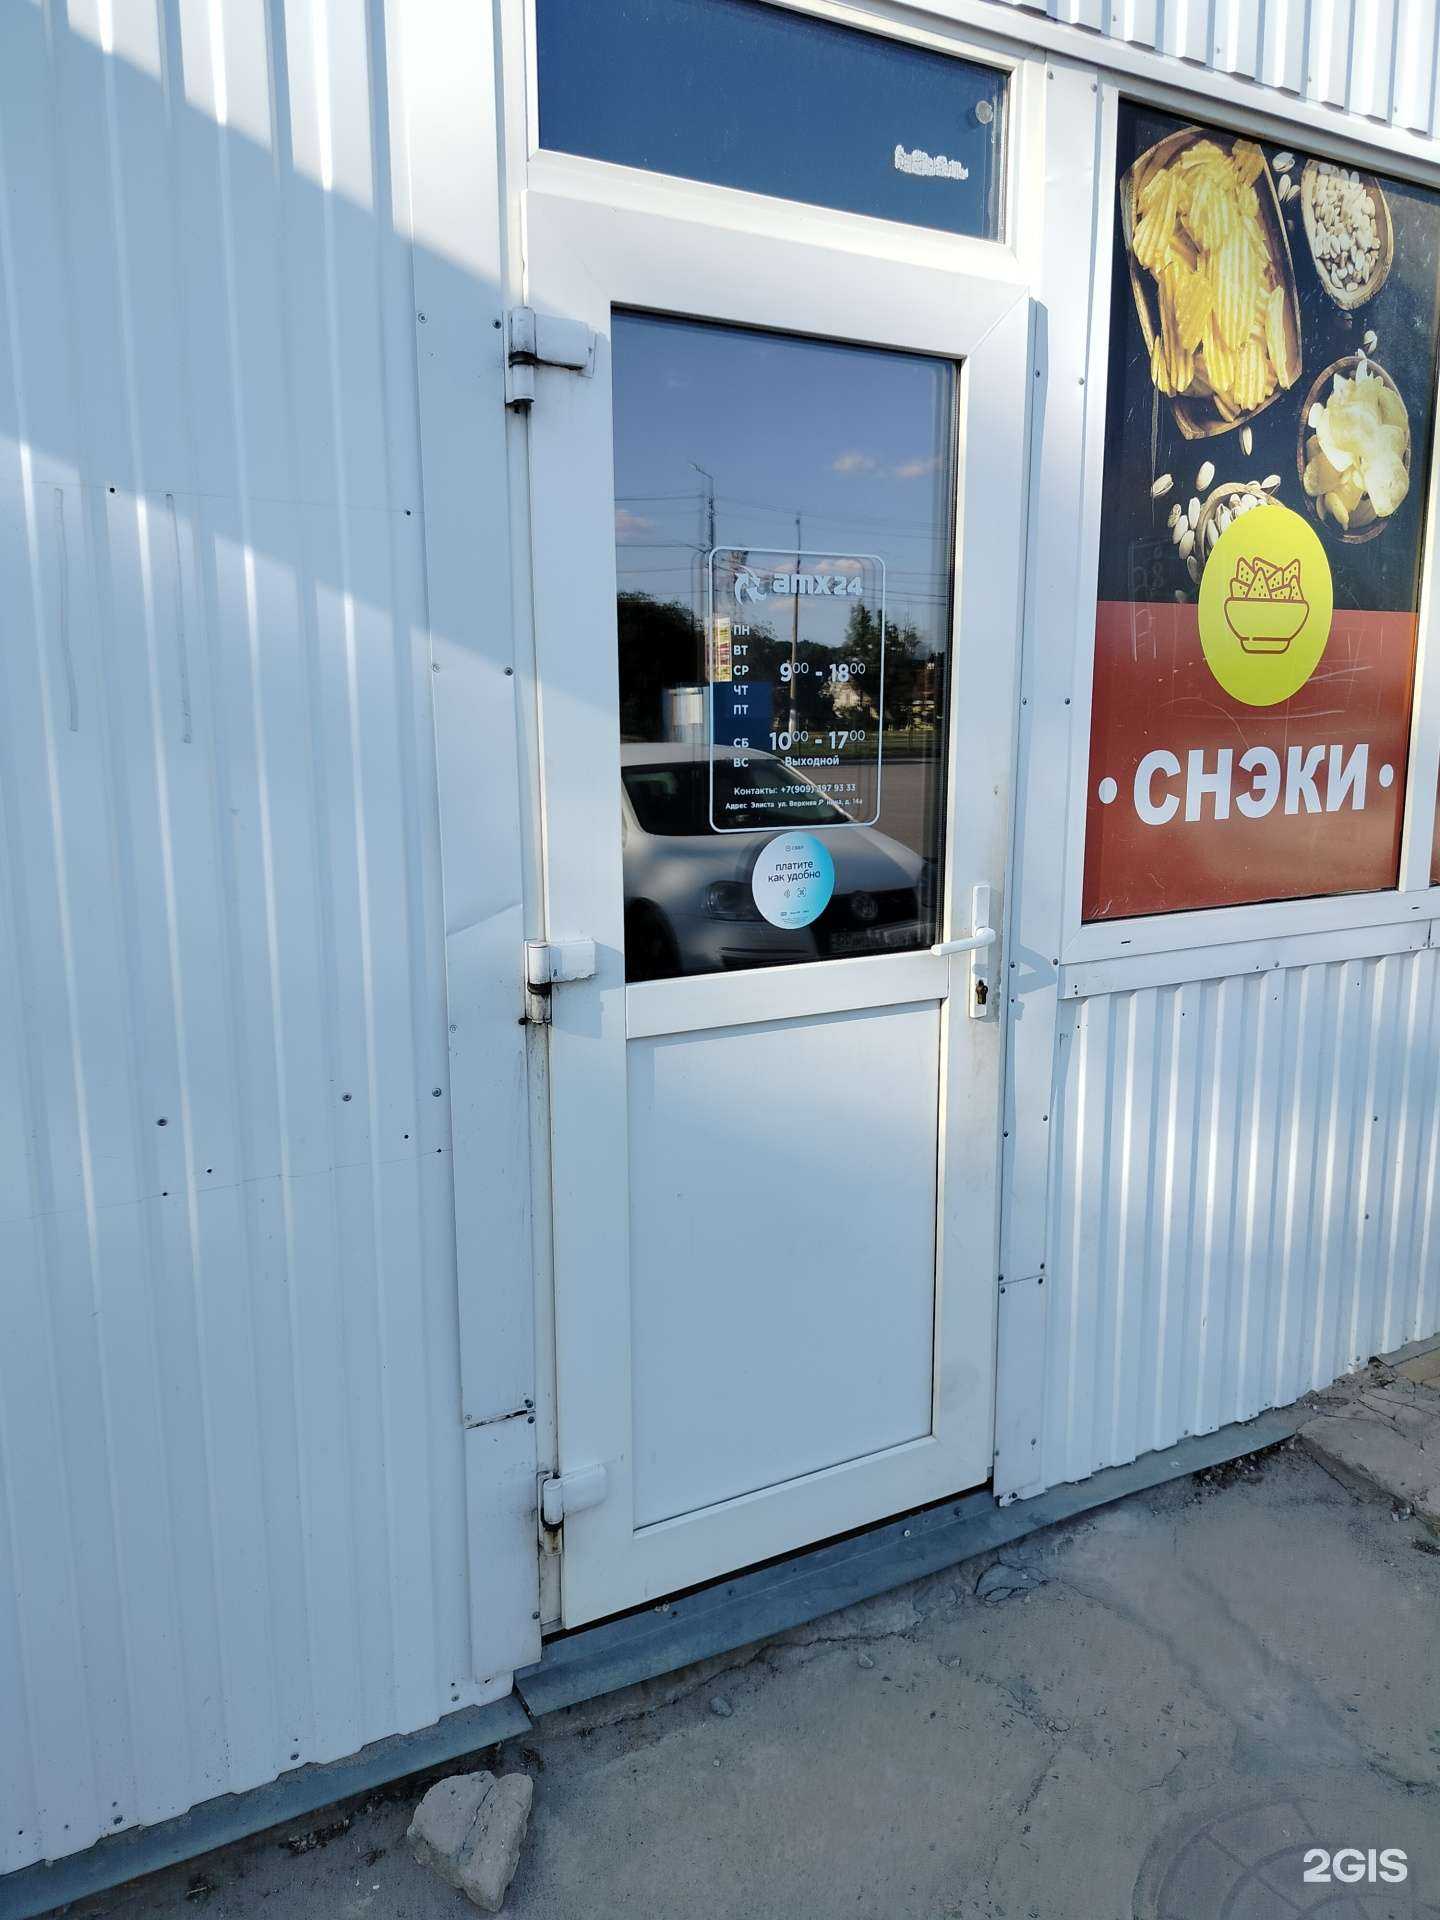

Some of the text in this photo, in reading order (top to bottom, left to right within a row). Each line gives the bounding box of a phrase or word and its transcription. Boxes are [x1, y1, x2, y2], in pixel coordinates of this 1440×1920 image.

[733, 624, 750, 636] ПН
[733, 645, 749, 656] ВТ
[733, 665, 750, 676] СР
[733, 685, 749, 696] ЧТ
[733, 704, 749, 716] ПТ
[733, 737, 749, 749] СБ
[733, 757, 749, 768] ВС
[784, 754, 840, 768] Выходной
[1133, 743, 1369, 826] СНЭКИ
[733, 787, 778, 796] Контакты:
[775, 860, 814, 872] платите
[768, 869, 821, 883] как удобно
